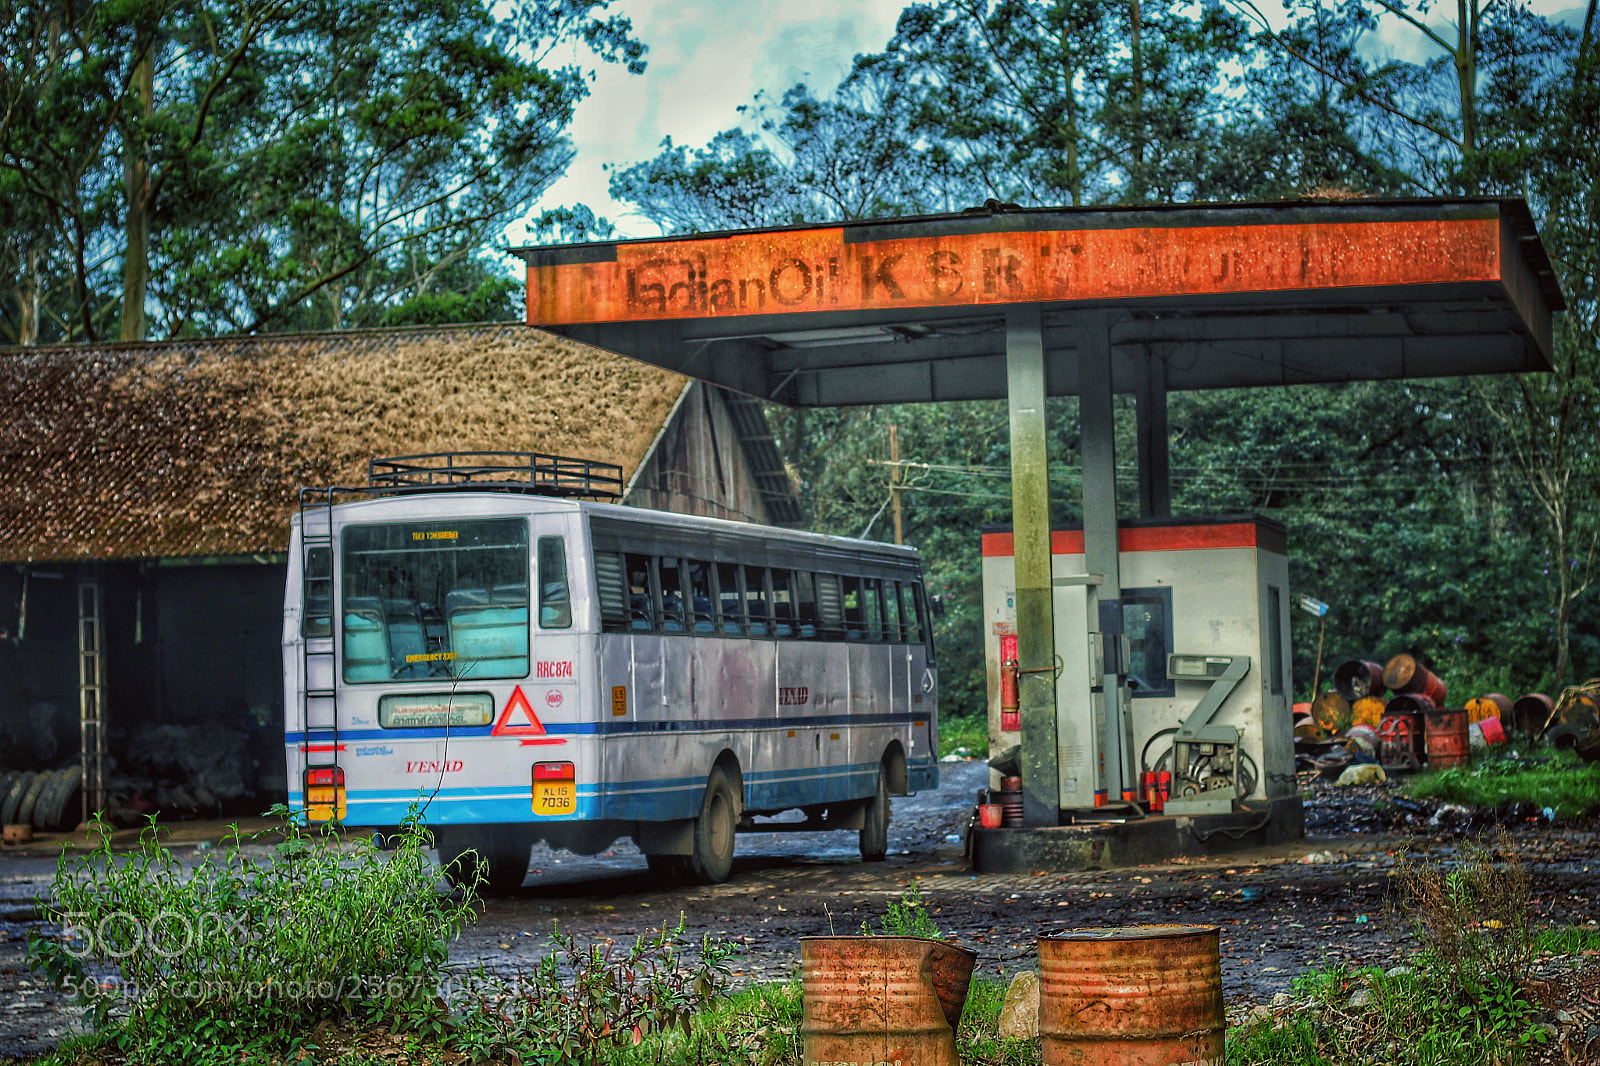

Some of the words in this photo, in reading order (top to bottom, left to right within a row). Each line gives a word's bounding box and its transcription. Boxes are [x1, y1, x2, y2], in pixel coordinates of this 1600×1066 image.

[537, 661, 572, 678] RRC874
[406, 761, 463, 773] VENAD
[542, 797, 570, 808] 7036
